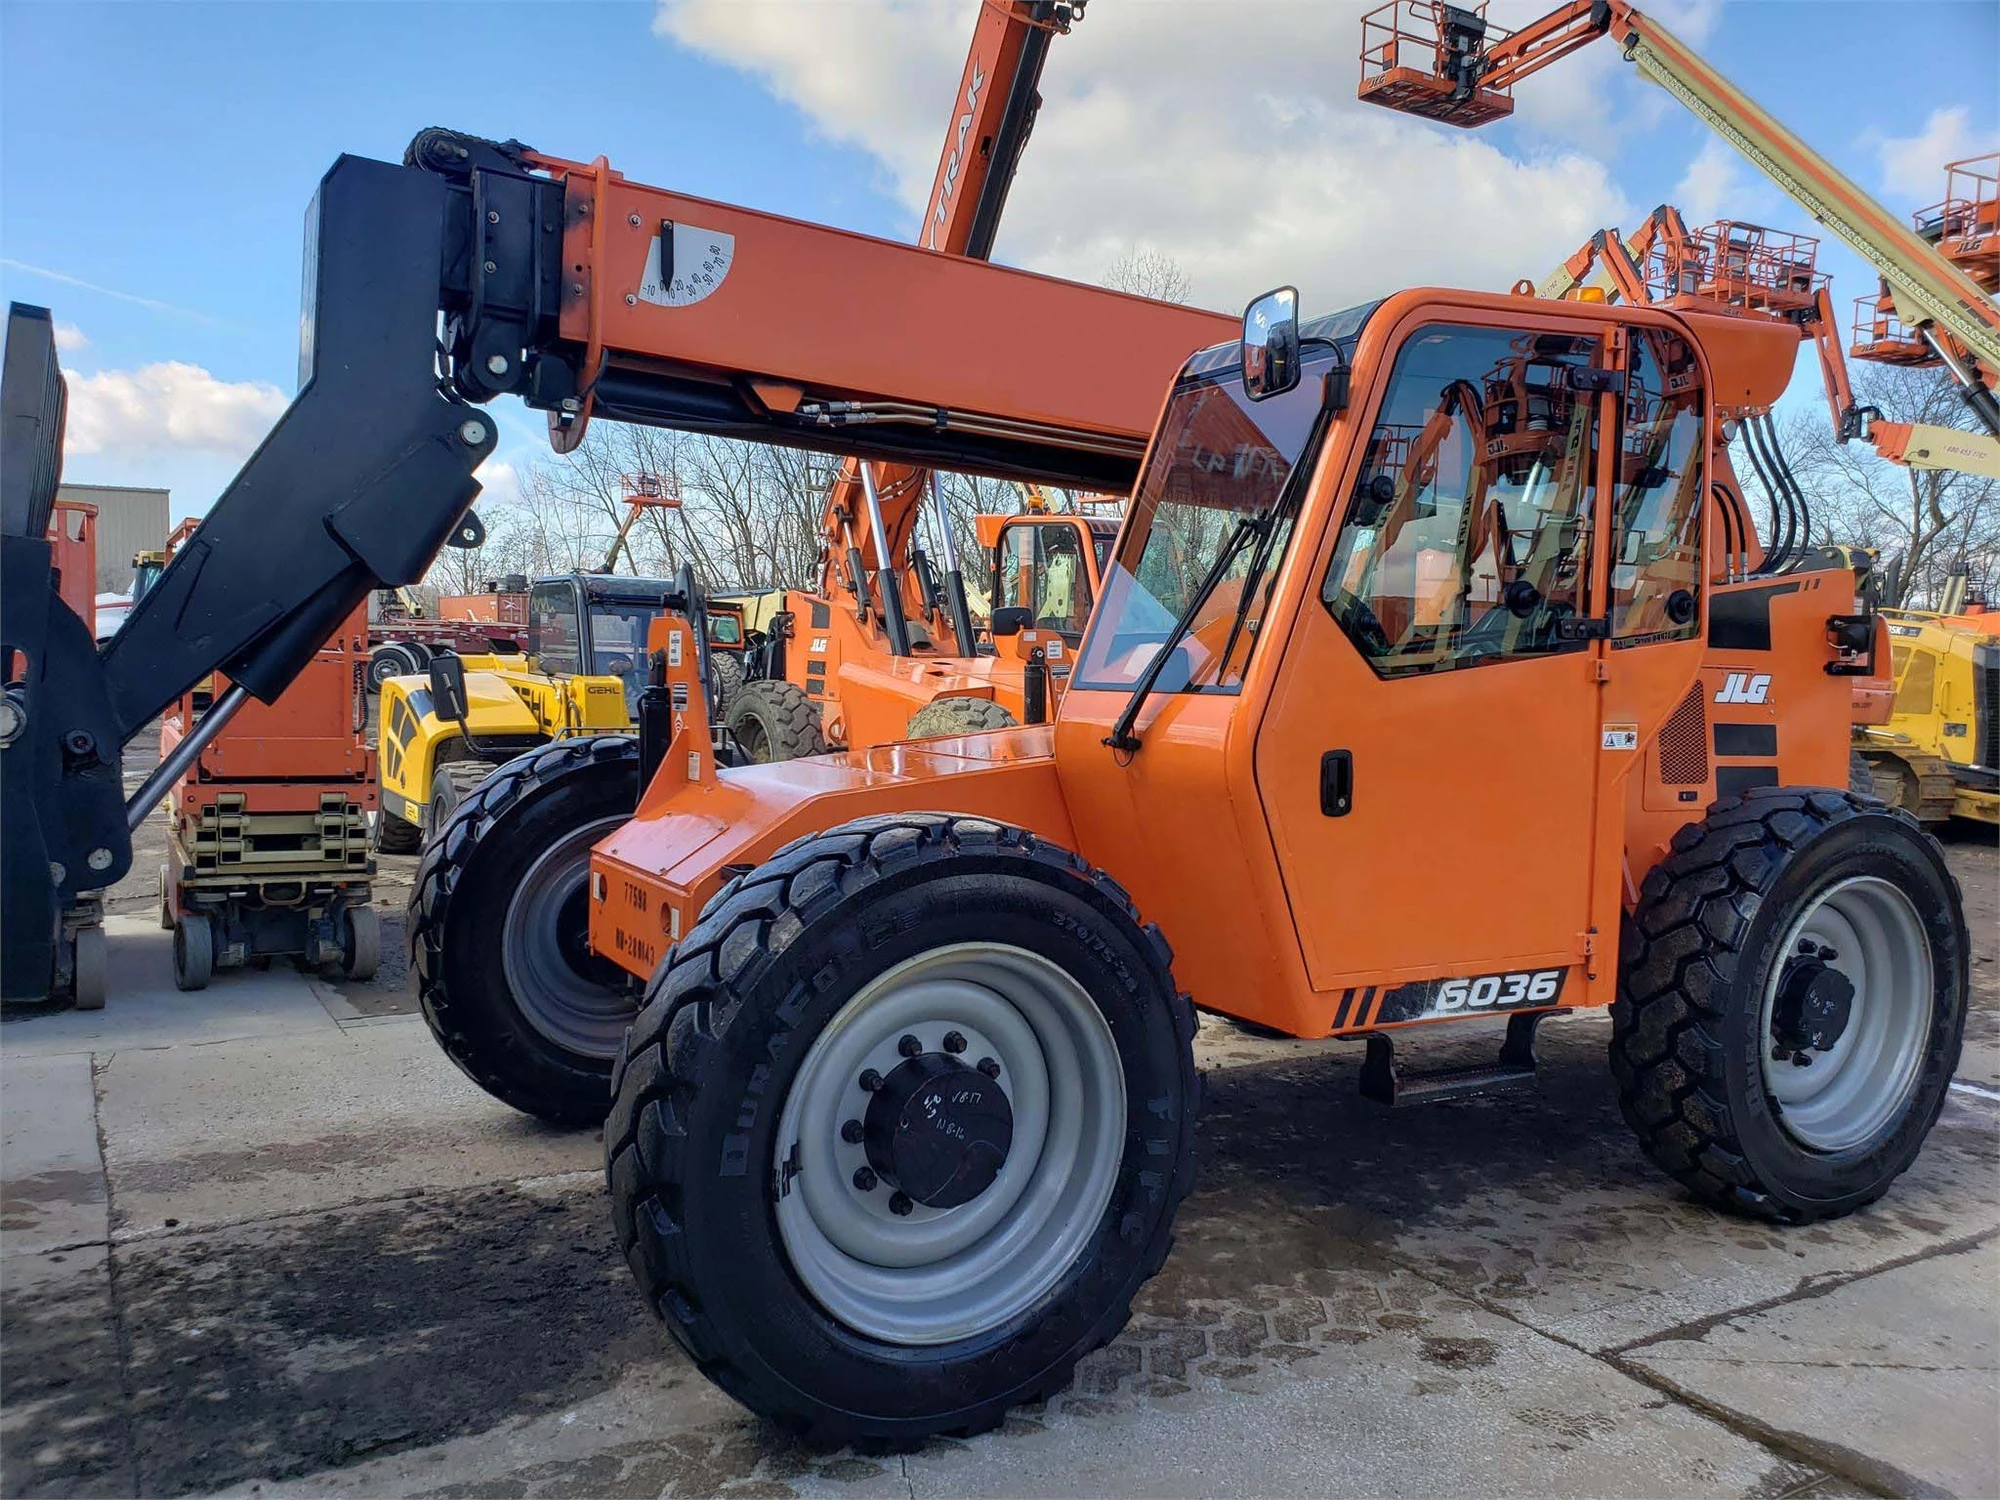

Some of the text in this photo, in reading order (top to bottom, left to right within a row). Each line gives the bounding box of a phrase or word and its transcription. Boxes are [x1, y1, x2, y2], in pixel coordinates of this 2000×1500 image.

[1954, 240, 1982, 254] JLG
[702, 260, 715, 273] 60
[713, 256, 725, 268] 70
[674, 279, 685, 291] 20
[691, 272, 702, 285] 40
[701, 273, 714, 286] 50
[685, 283, 697, 297] 30
[810, 638, 828, 652] JLG
[587, 686, 621, 695] GEHL
[1713, 672, 1772, 704] JLG
[1435, 970, 1561, 1012] 6036
